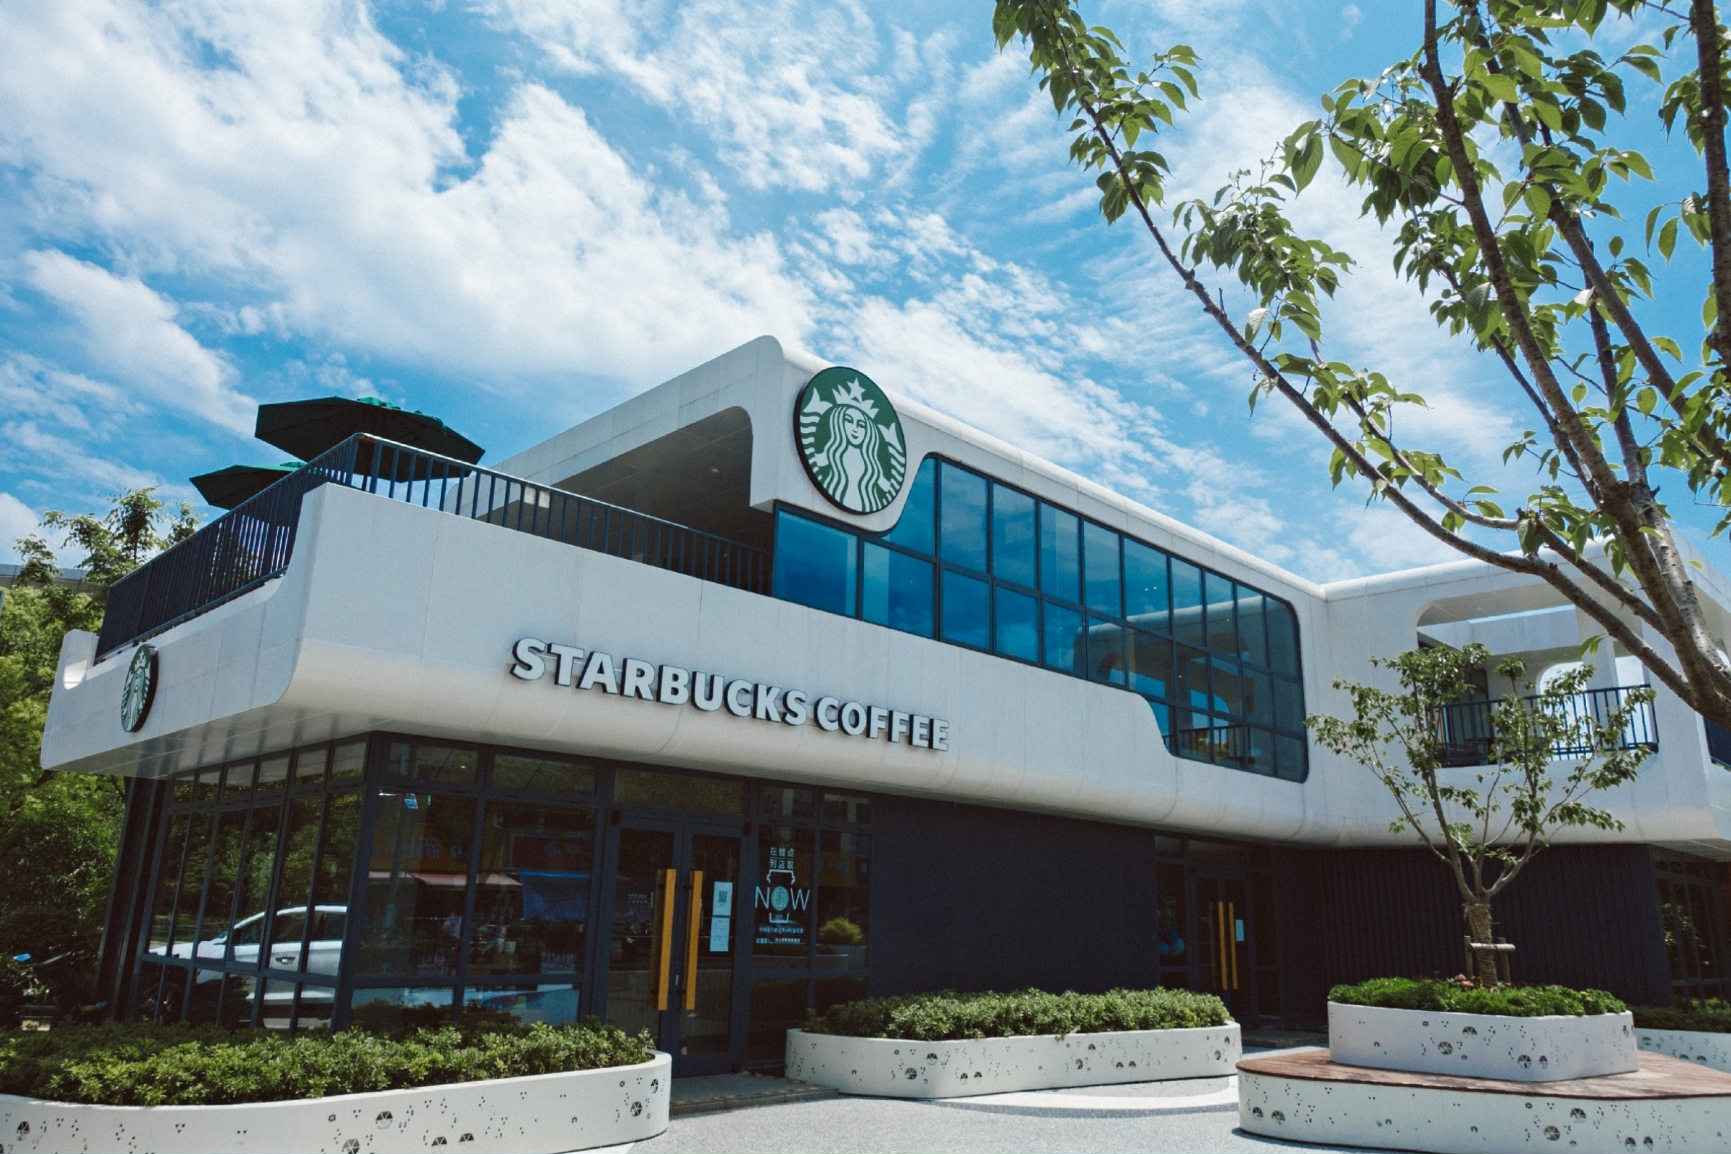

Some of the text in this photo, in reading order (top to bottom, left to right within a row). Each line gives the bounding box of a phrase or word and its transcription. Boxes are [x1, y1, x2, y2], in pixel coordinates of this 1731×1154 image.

[510, 637, 949, 752] STARBUCKS COFFEE
[754, 885, 810, 911] NOW
